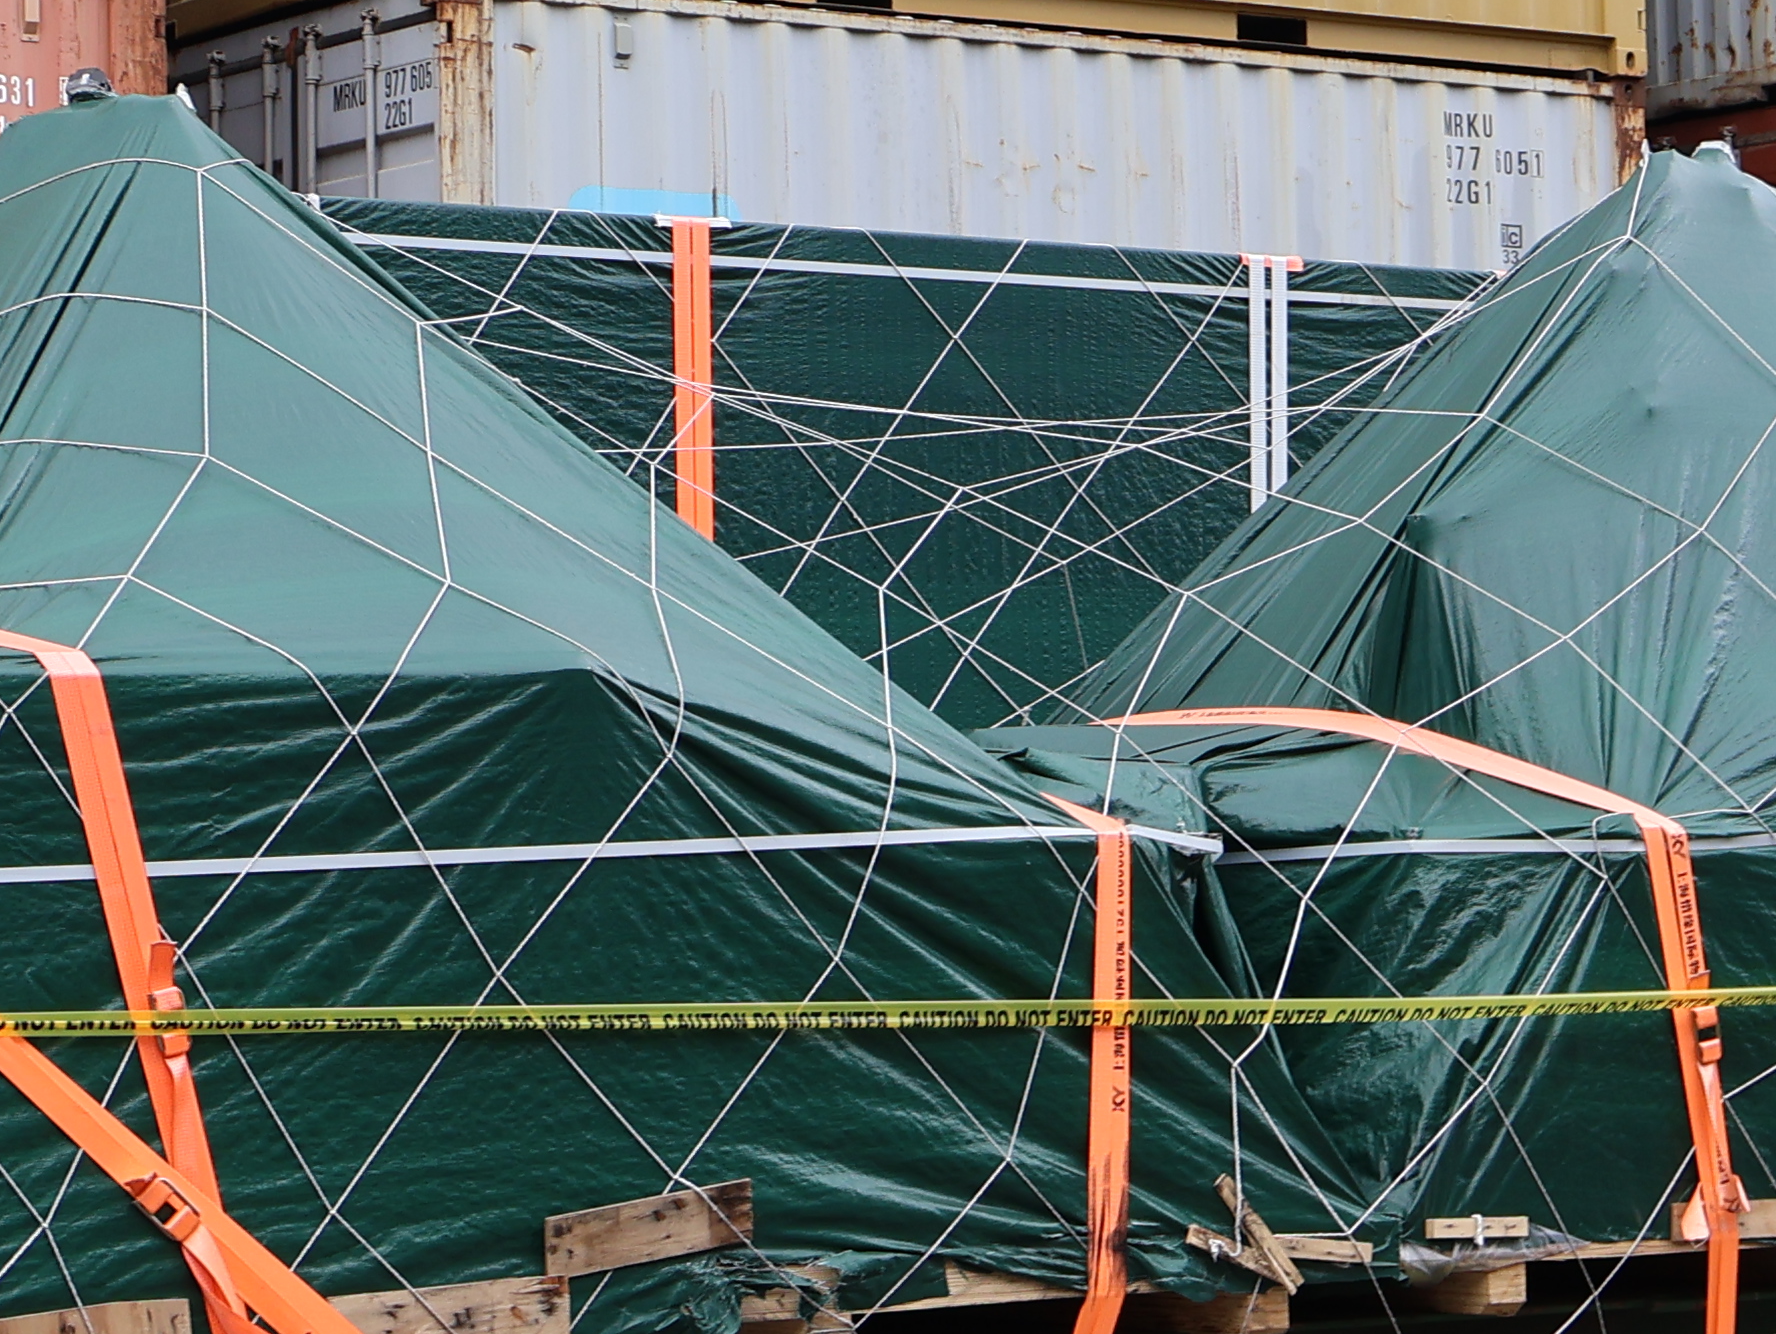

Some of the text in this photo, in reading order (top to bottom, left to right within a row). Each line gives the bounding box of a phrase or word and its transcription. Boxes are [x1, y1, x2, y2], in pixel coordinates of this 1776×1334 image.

[384, 67, 407, 99] 977
[410, 61, 433, 93] 605
[384, 97, 413, 130] 22G1
[1442, 110, 1493, 138] MRKU
[1445, 144, 1481, 171] 977
[1445, 177, 1492, 205] 22G1
[1122, 1008, 1328, 1026] CAUTION DO NOT ENTER
